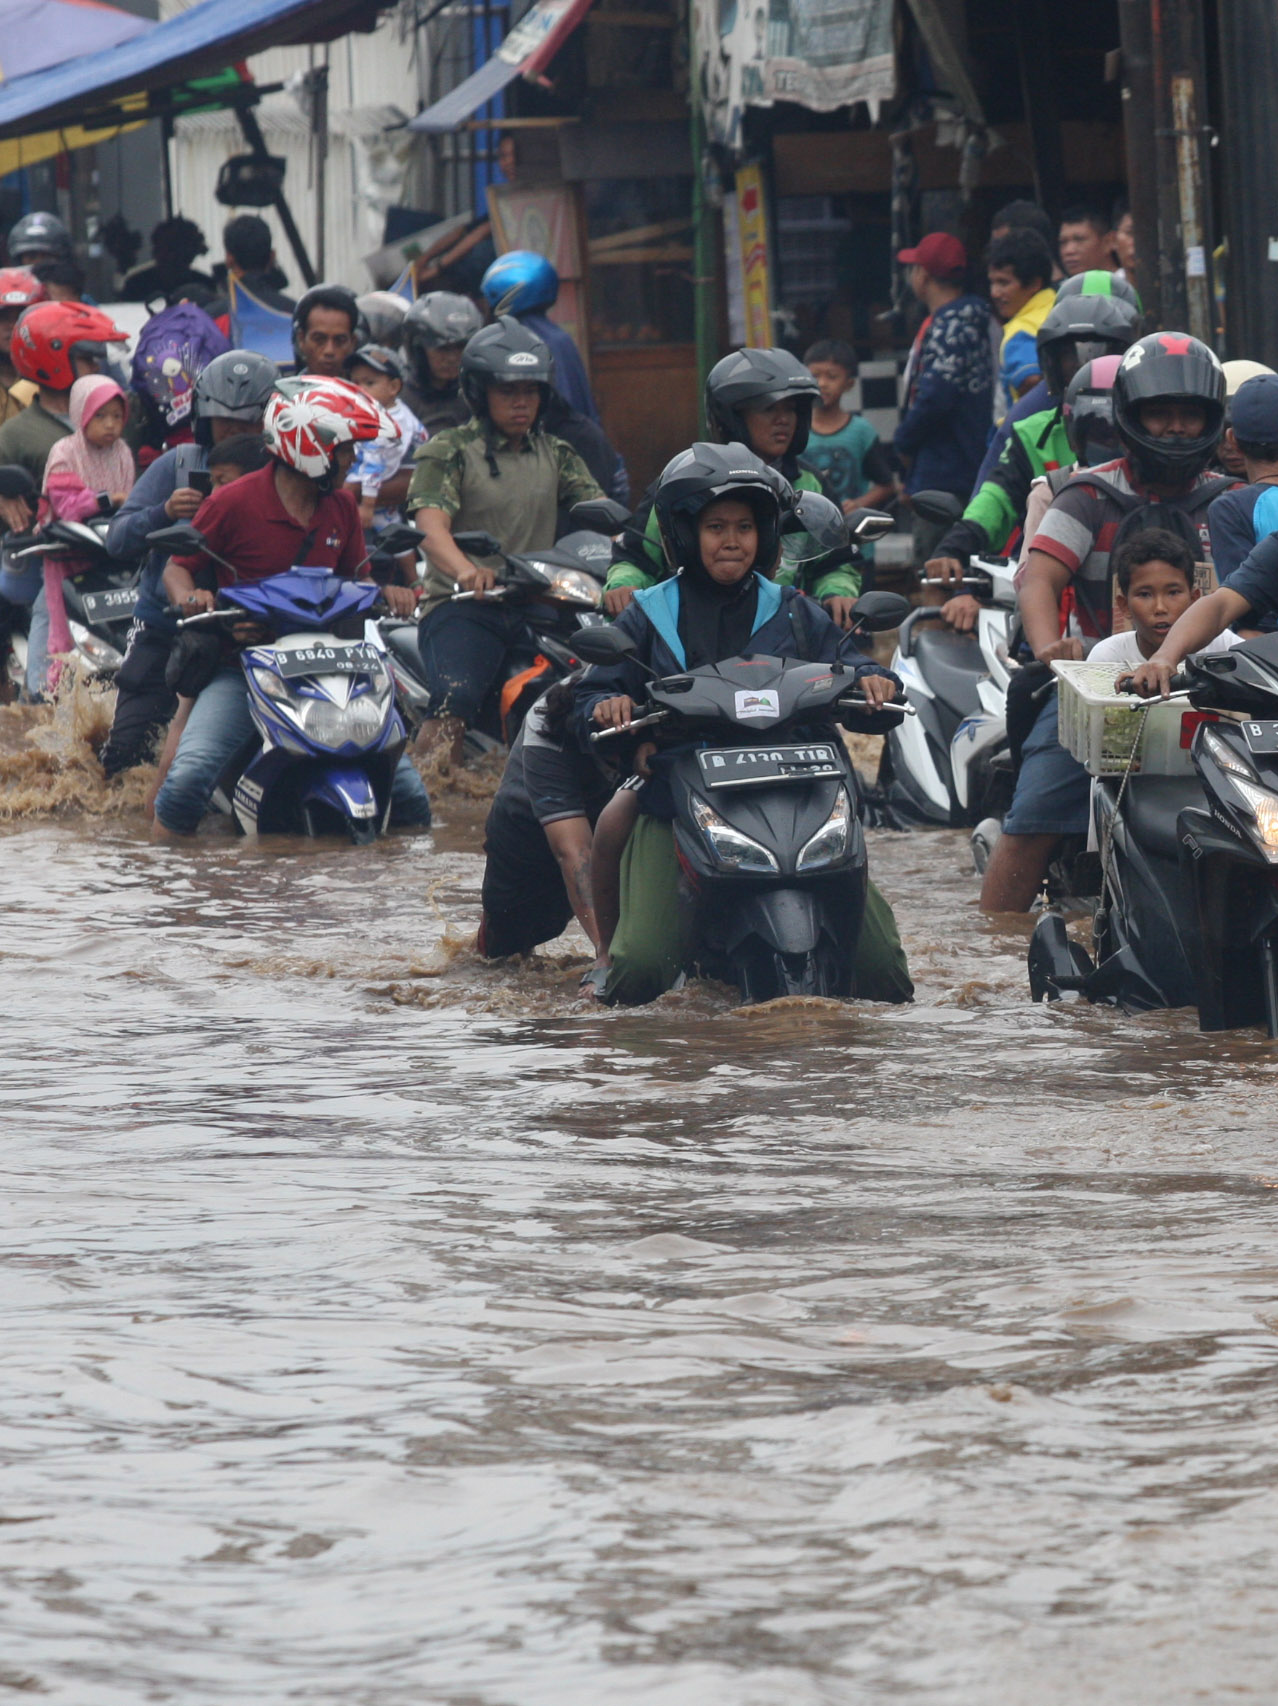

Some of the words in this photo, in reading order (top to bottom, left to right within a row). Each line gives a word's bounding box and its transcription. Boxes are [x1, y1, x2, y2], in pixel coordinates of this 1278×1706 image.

[277, 652, 288, 665] B
[1249, 723, 1263, 737] B
[1214, 809, 1243, 840] HONDA
